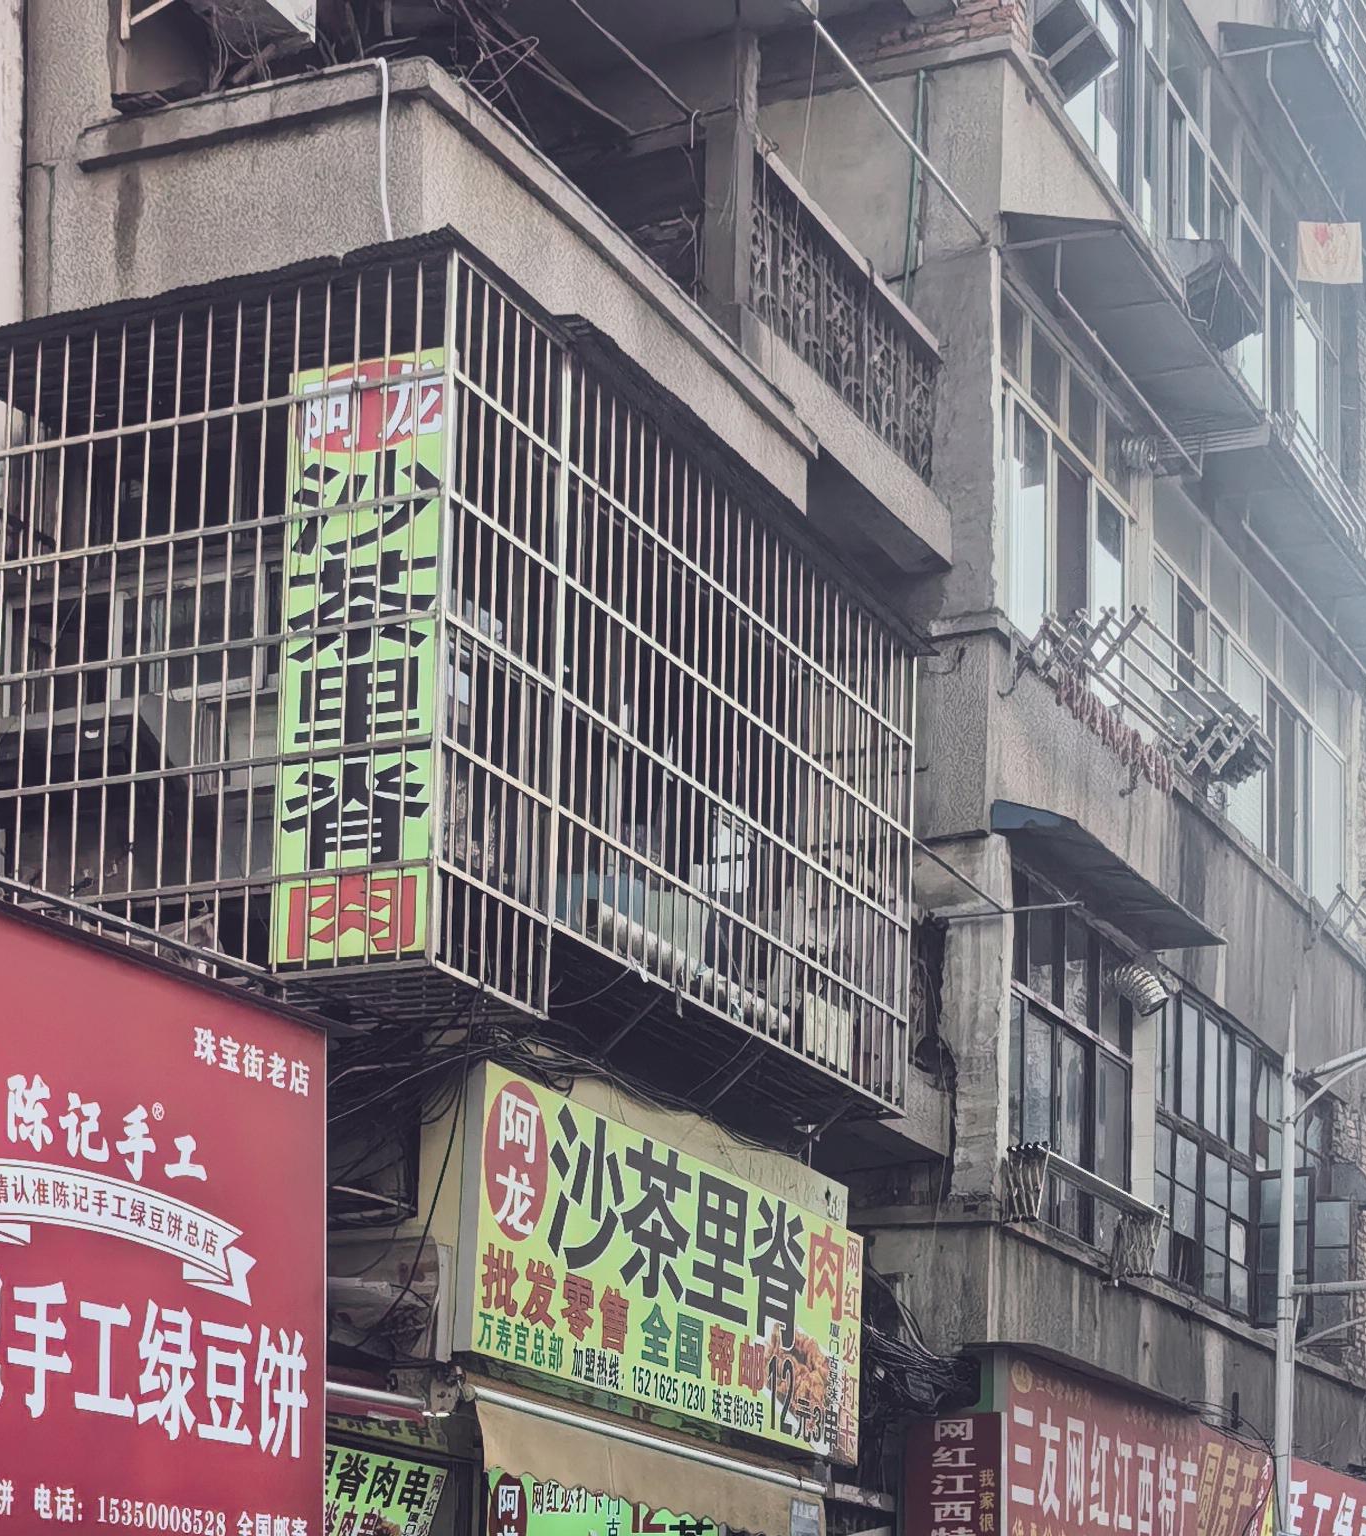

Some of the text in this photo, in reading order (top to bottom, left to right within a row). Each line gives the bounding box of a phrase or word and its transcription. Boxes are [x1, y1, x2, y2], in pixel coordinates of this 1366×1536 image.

[303, 361, 443, 453] 阿龙
[193, 1027, 310, 1097] 珠宝街老店
[6, 1073, 207, 1183] 陈记手工
[494, 1090, 540, 1235] 阿龙
[548, 1102, 844, 1351] 沙茶里脊肉
[477, 1311, 565, 1372] 万寿宫总部
[711, 1388, 765, 1433] 珠宝街83号
[481, 1242, 766, 1396] 批发零售 全国帮邮
